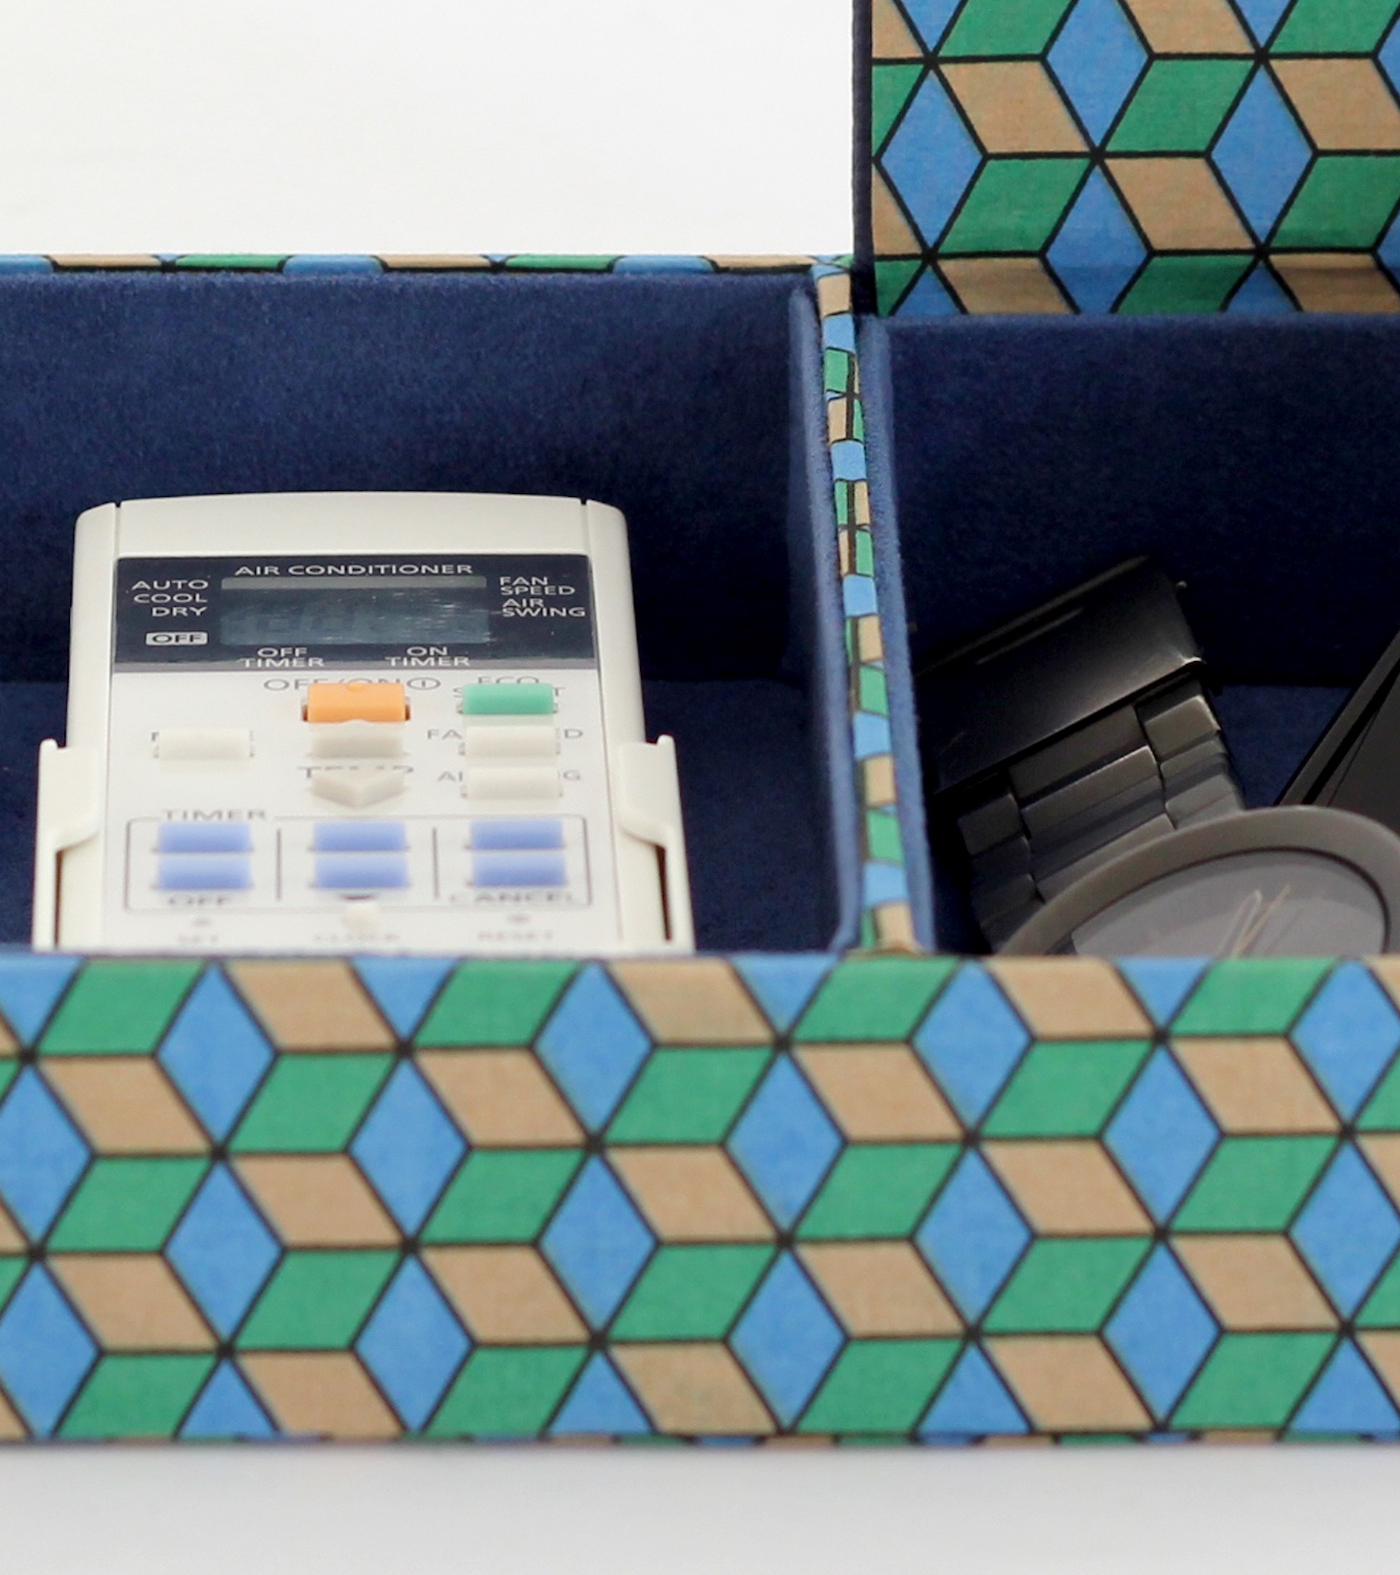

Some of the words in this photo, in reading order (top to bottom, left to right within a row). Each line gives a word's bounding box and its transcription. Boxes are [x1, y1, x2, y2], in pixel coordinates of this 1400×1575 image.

[234, 565, 280, 576] AIR
[288, 564, 473, 576] CONDITIONER
[131, 579, 209, 591] AUTO
[499, 576, 548, 586] FAN
[500, 586, 576, 596] SPEED
[133, 593, 208, 604] COOL
[502, 598, 544, 608] AIR
[151, 606, 208, 617] DRY
[501, 607, 586, 618] SWING
[151, 634, 203, 644] OFF
[257, 647, 308, 658] OFF
[406, 646, 448, 656] ON
[240, 657, 325, 668] TIMER
[385, 656, 471, 667] TIMER
[163, 809, 266, 821] TIMER
